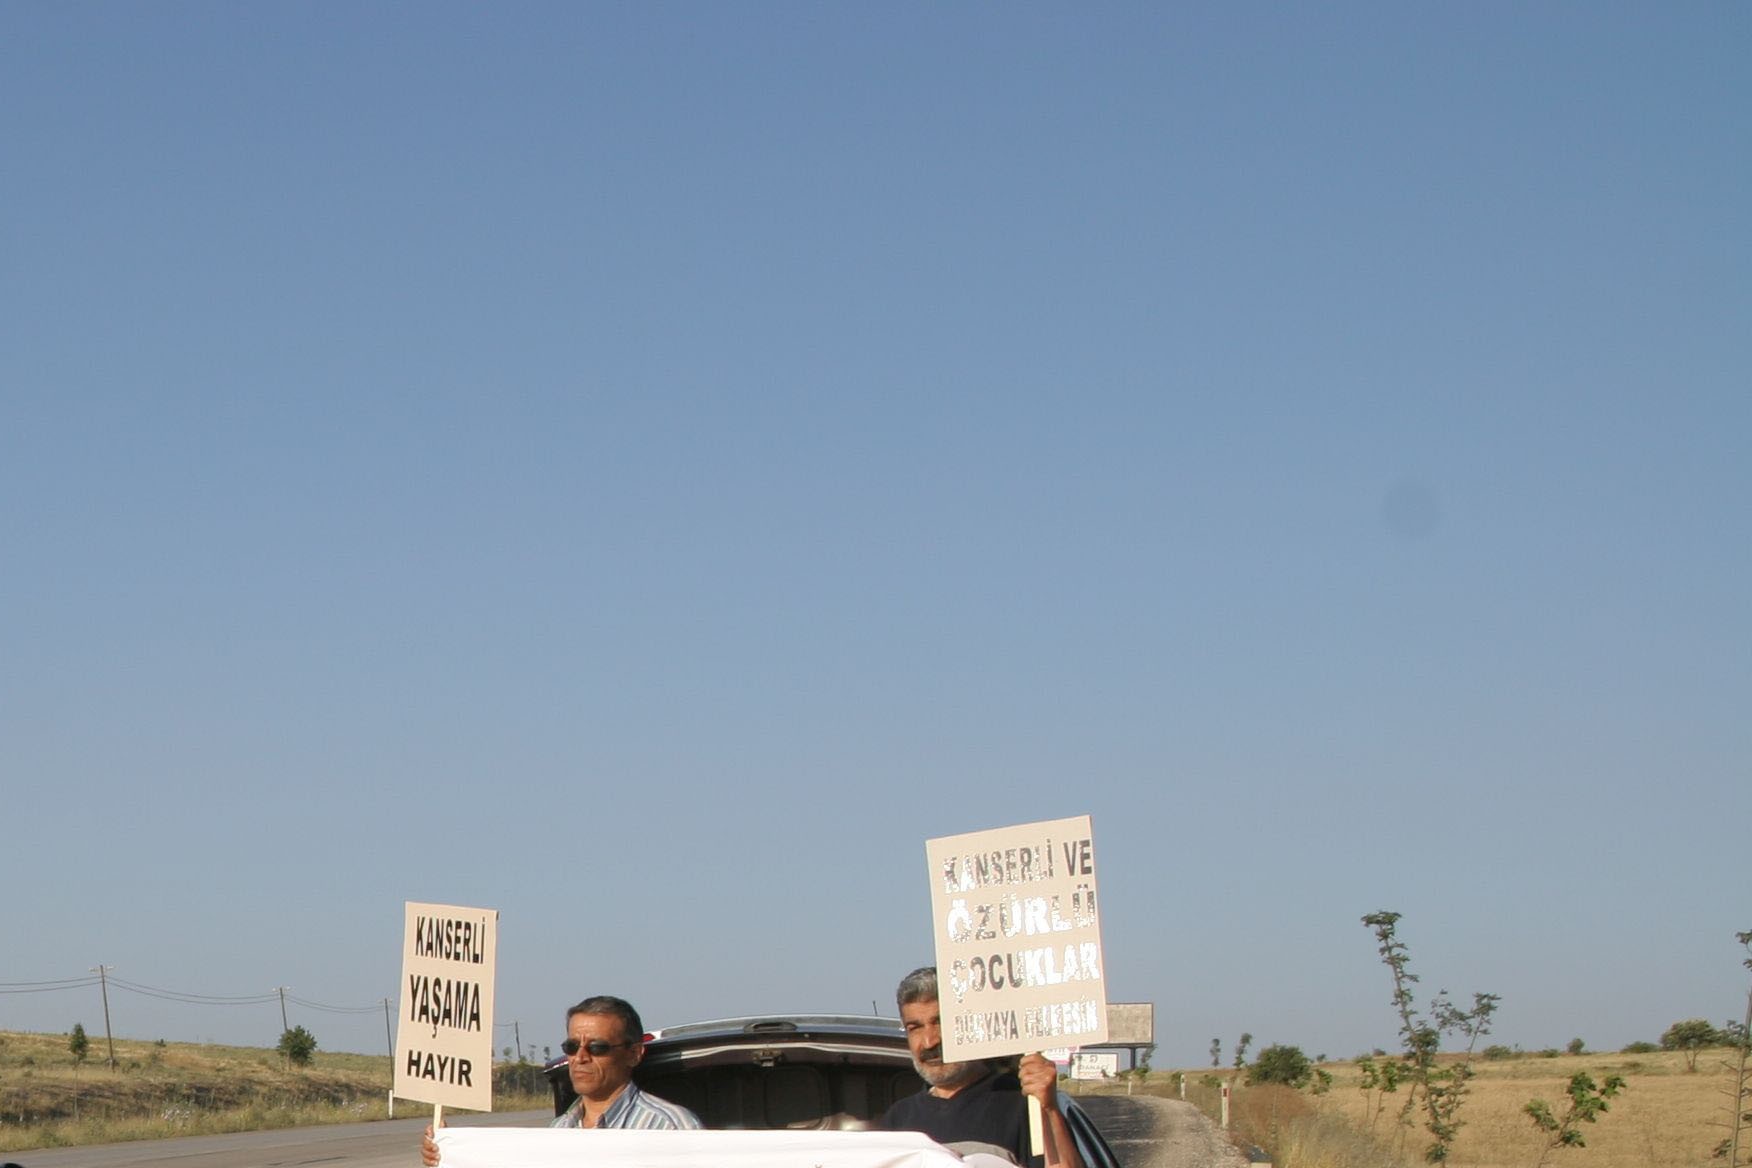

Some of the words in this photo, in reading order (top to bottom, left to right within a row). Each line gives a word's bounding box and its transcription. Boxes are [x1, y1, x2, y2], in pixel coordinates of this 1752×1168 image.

[943, 839, 1054, 893] KANSERLİ
[1063, 839, 1093, 876] VE
[416, 915, 486, 964] KANSERLİ
[948, 884, 1096, 942] ÖZÜRLÜ
[950, 942, 1100, 1003] ÇOCUKLAR
[410, 974, 482, 1038] YAŞAMA
[407, 1049, 473, 1087] HAYIR
